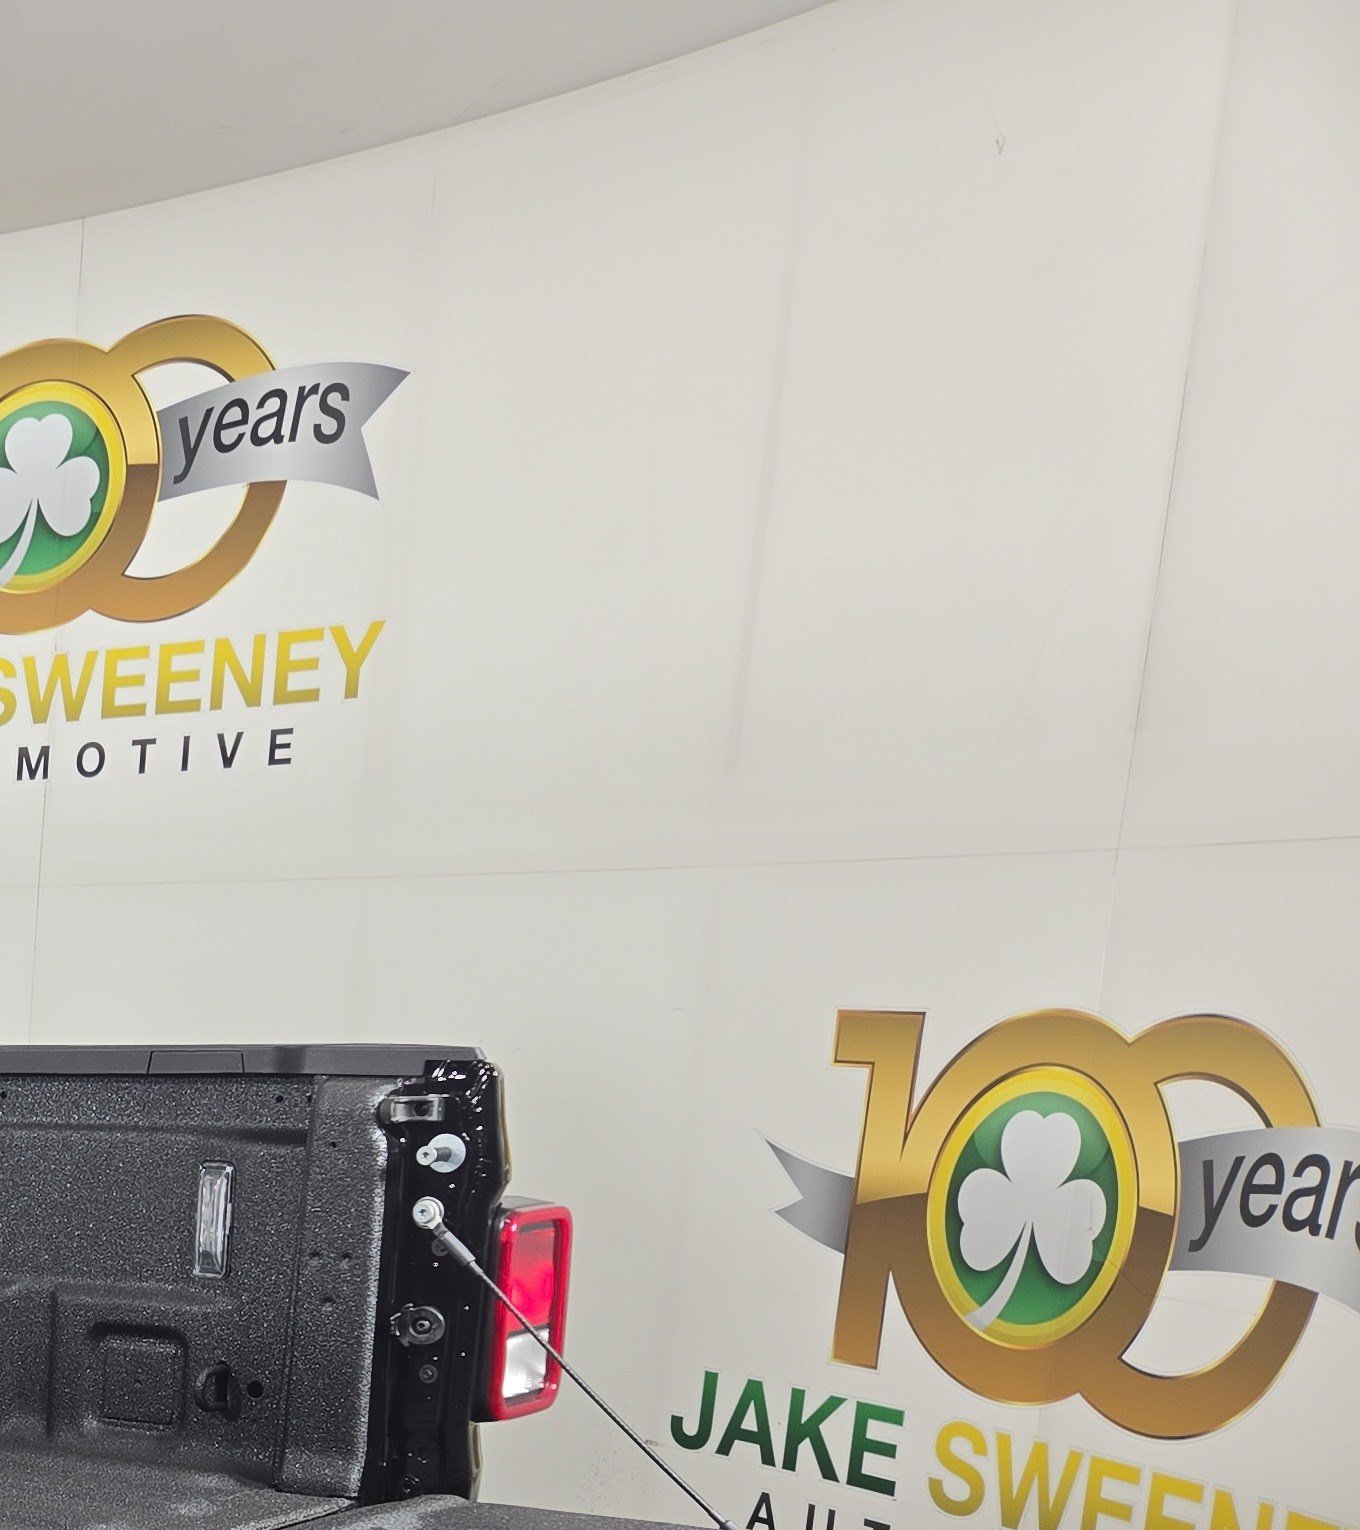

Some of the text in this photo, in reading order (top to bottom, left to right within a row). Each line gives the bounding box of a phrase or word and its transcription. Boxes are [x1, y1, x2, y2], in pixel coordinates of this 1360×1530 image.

[173, 380, 350, 484] years
[832, 1008, 1360, 1438] 100 year
[670, 1369, 905, 1498] JAKE
